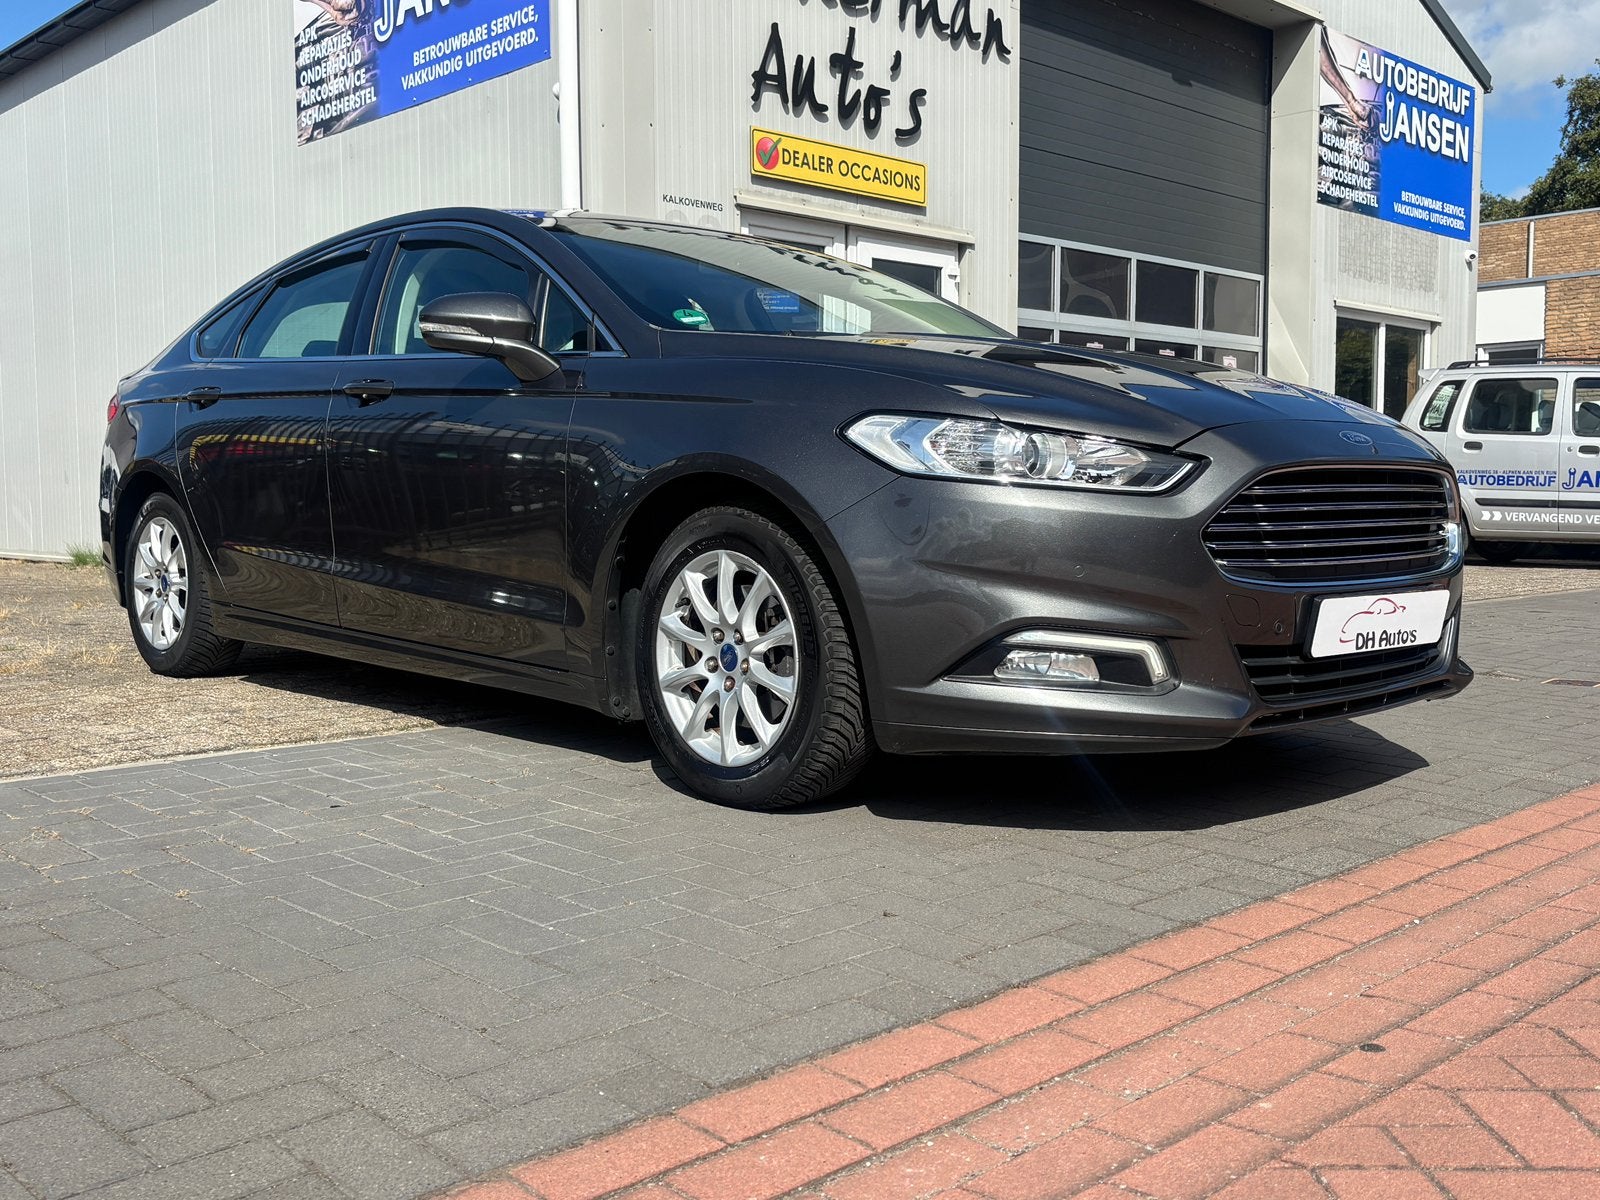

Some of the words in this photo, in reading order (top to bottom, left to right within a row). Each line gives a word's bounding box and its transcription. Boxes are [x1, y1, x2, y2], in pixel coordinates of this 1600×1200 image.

[299, 25, 318, 46] APK
[300, 30, 352, 66] REPARATIES
[413, 24, 488, 67] BETROUWBARE
[491, 5, 539, 37] SERVICE,
[300, 49, 361, 86] ONDERHOUD
[401, 55, 463, 90] VAKKUNDIG
[466, 28, 539, 67] UITGEVOERD.
[301, 68, 366, 108] AIRCOSERVICE
[751, 22, 927, 138] Auto's
[1355, 48, 1470, 116] AUTOBEDRIJF
[301, 86, 377, 127] SCHADEHERSTEL
[1322, 116, 1338, 131] APK
[1379, 91, 1470, 162] JANSEN
[1322, 133, 1363, 156] REPARATIES
[782, 148, 834, 174] DEALER
[839, 160, 921, 191] OCCASIONS
[1322, 149, 1369, 173] ONDERHOUD
[1321, 165, 1372, 190] AIRCOSERVICE
[662, 194, 723, 211] KALKOVENWEG
[1321, 181, 1378, 207] SCHADEHERSTEL
[1401, 190, 1443, 212] BETROUWBARE
[1443, 203, 1466, 219] SERVICE,
[1393, 202, 1429, 221] VAKKUNDIG
[1430, 212, 1466, 231] UITGEVOERD.
[1457, 475, 1557, 487] AUTOBEDRIJF
[1505, 512, 1582, 524] VERVANGEND
[1355, 631, 1376, 650] DH
[1378, 629, 1418, 647] Auto's
